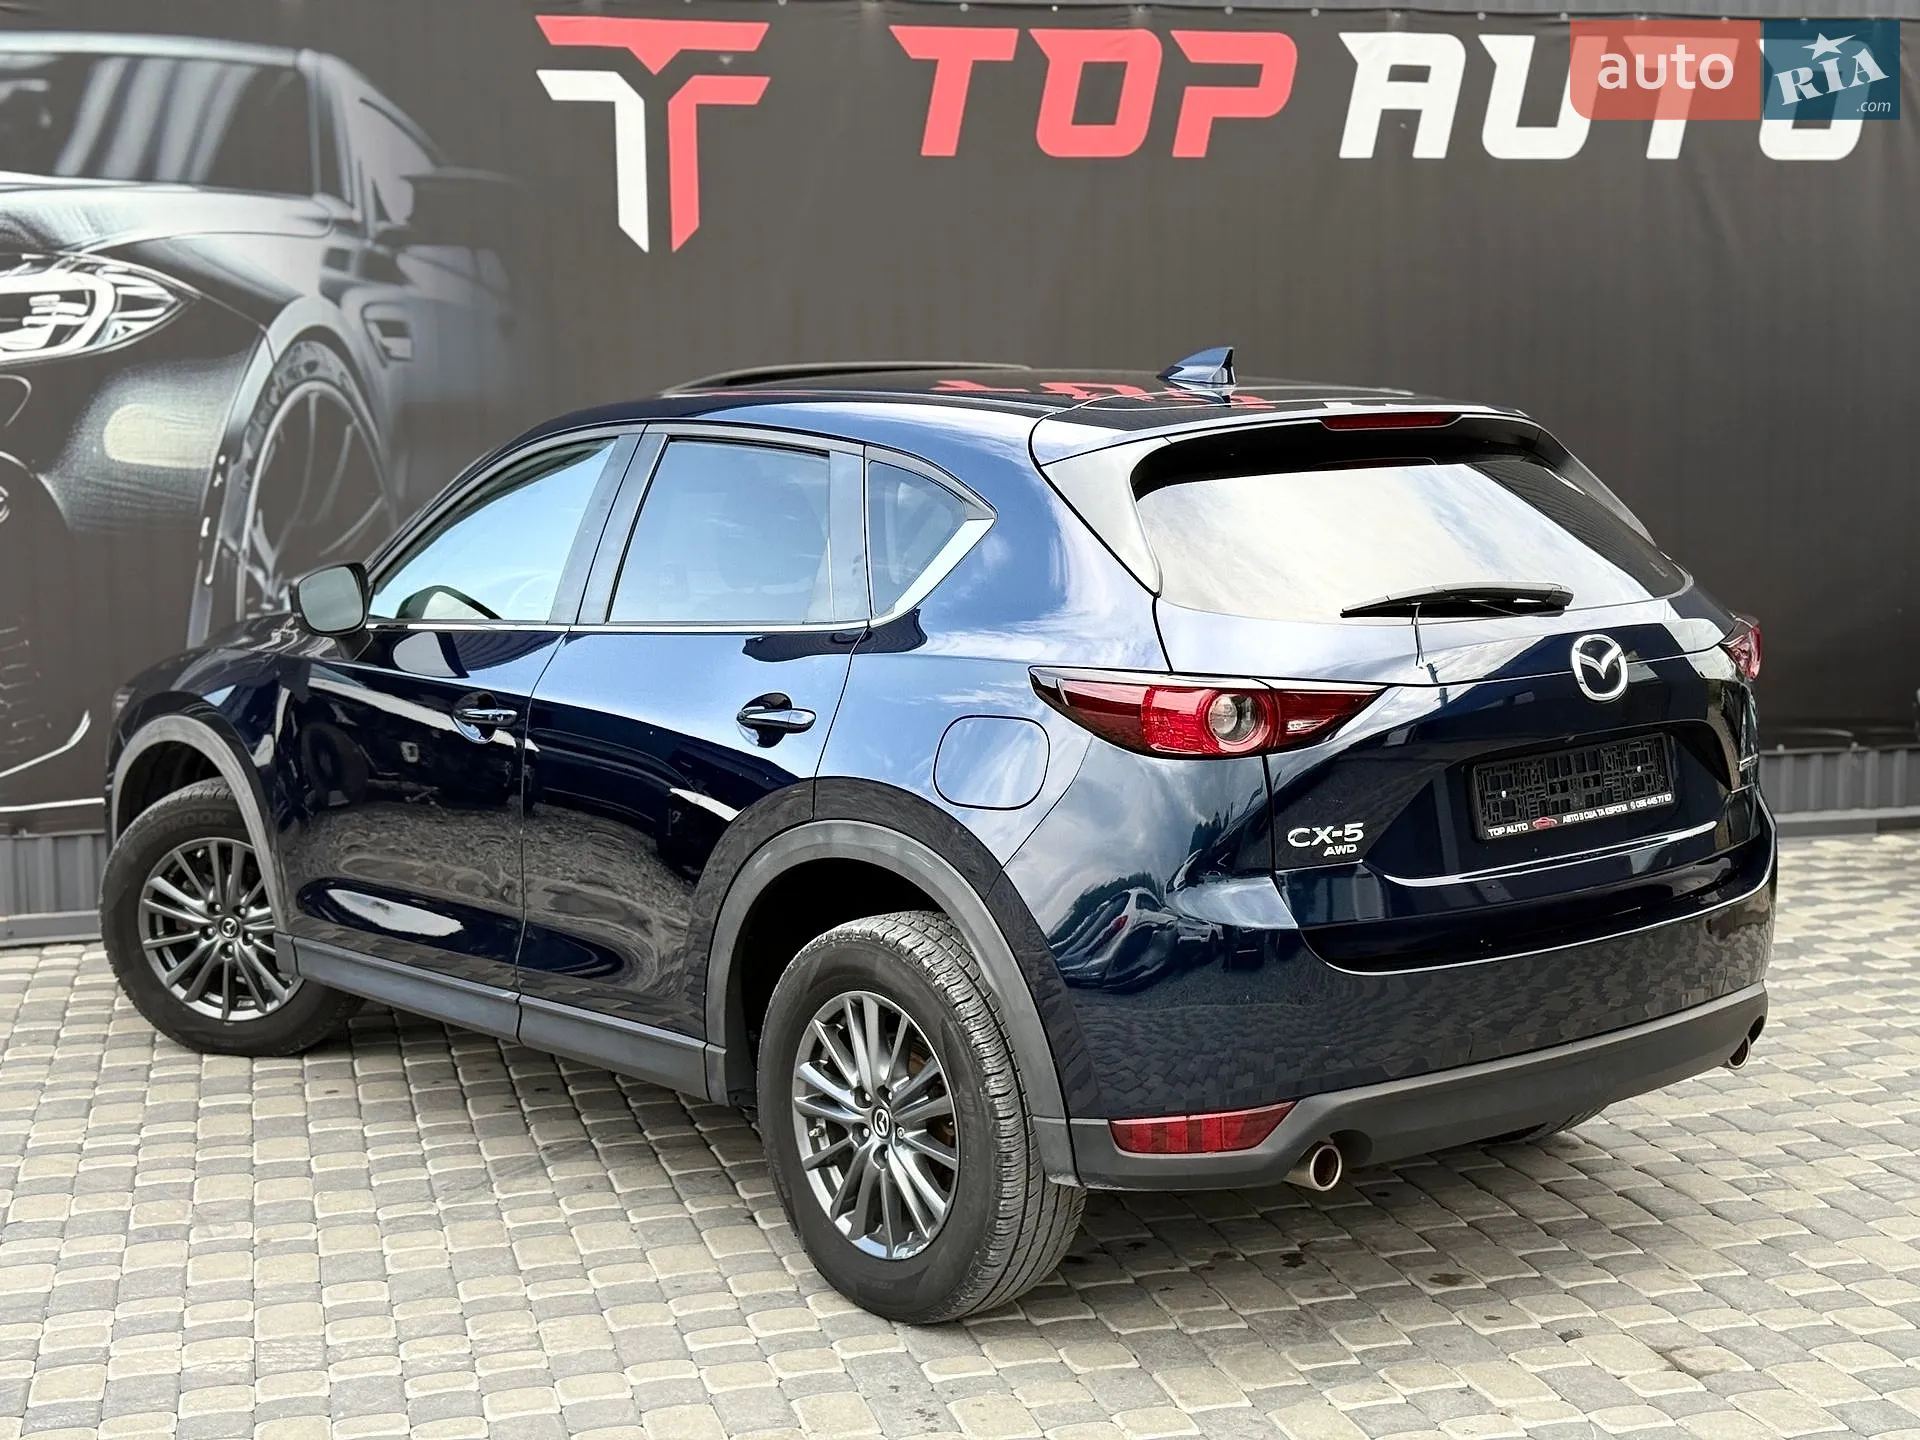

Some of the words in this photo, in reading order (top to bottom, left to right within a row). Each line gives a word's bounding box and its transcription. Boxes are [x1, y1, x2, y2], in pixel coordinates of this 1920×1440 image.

[889, 25, 1298, 158] TOP
[1338, 31, 1874, 160] AUTO
[1287, 822, 1364, 848] CX-5
[1488, 826, 1506, 837] TOP
[1506, 822, 1529, 834] AUTO
[1323, 843, 1358, 857] AWD
